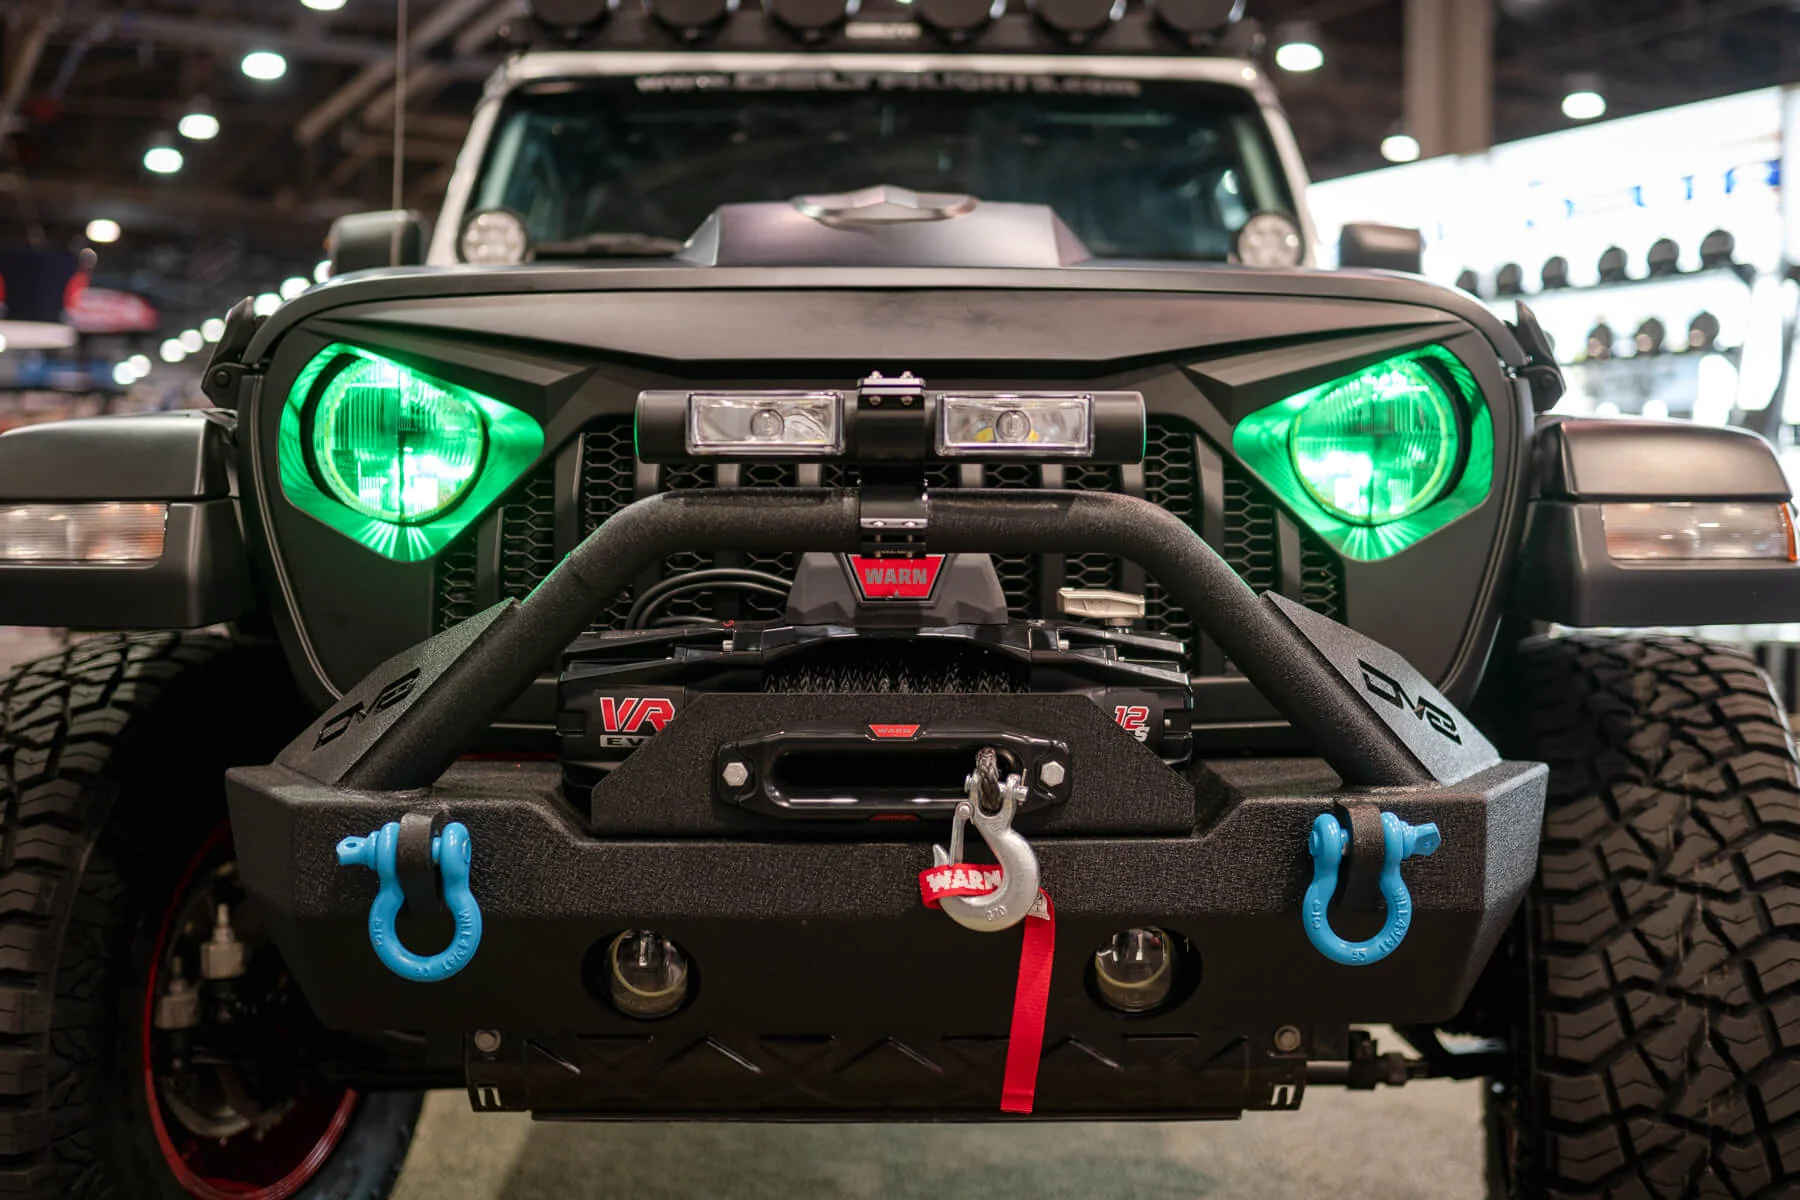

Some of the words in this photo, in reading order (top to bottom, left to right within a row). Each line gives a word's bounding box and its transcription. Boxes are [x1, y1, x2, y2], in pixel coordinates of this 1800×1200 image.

[865, 567, 927, 585] WARN
[600, 697, 675, 732] VR
[1115, 705, 1149, 731] 12
[926, 869, 1001, 892] WARN
